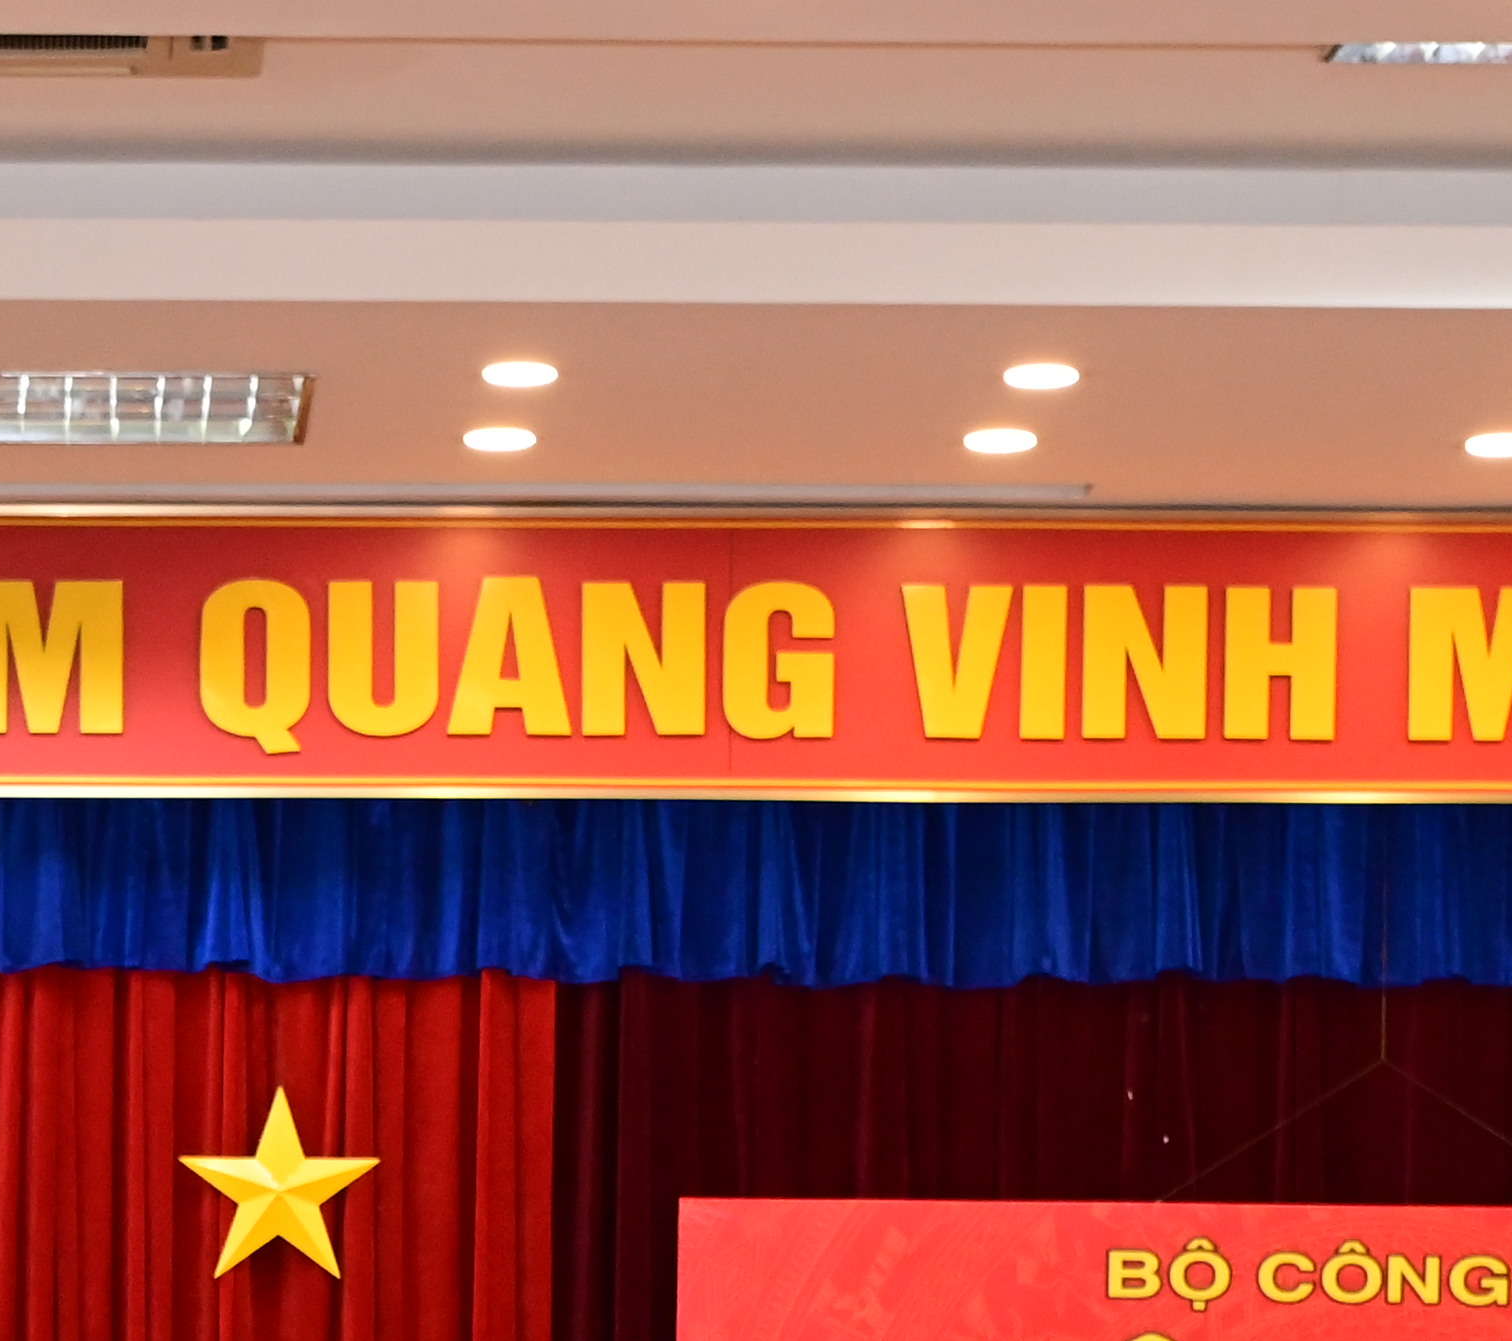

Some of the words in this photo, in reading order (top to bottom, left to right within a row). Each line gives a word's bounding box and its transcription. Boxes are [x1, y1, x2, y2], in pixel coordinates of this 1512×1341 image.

[199, 574, 835, 754] QUANG
[900, 582, 1338, 741] VINH
[1108, 1238, 1230, 1311] BỘ
[1258, 1241, 1508, 1306] CÔNG
